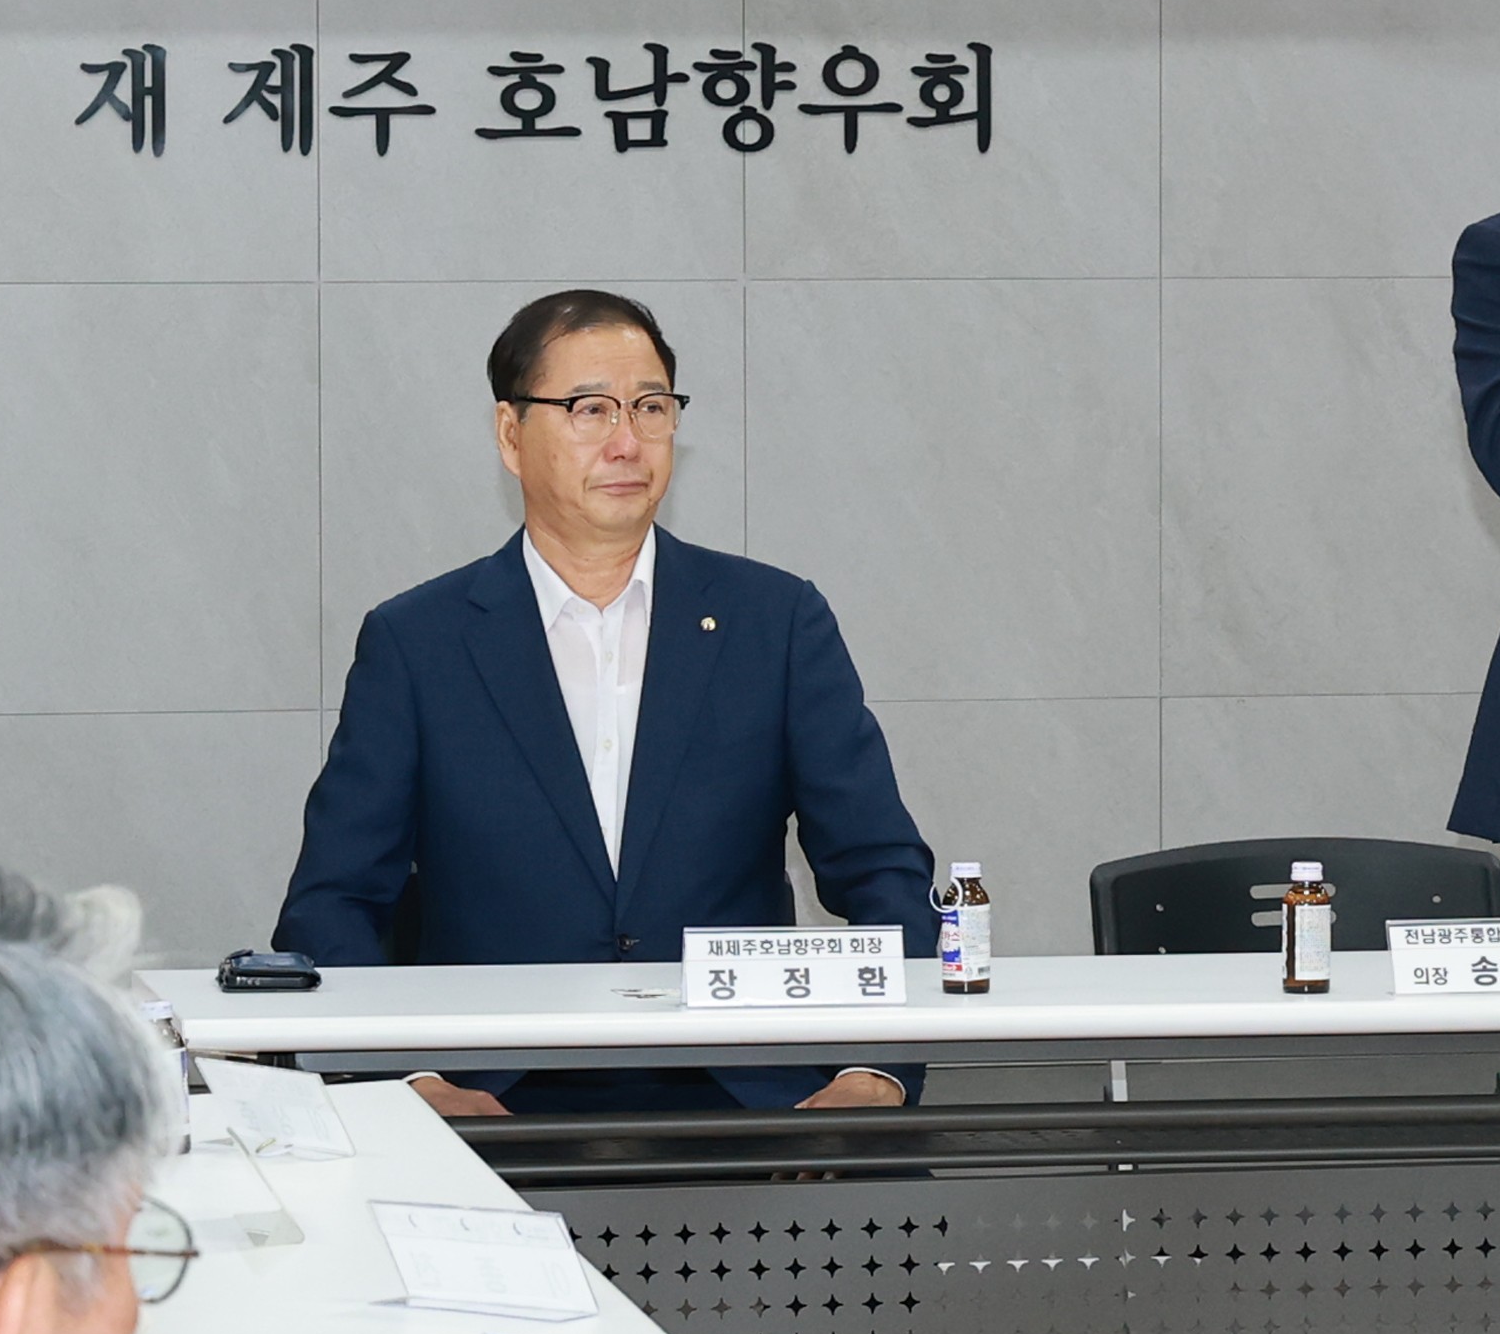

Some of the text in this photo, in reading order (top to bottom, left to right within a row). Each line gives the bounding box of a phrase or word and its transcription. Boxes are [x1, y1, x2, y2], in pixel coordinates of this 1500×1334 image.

[73, 41, 994, 158] 재 제주 호남향우회
[707, 936, 884, 957] 재제주호남향우회 회장
[1413, 966, 1449, 987] 의장
